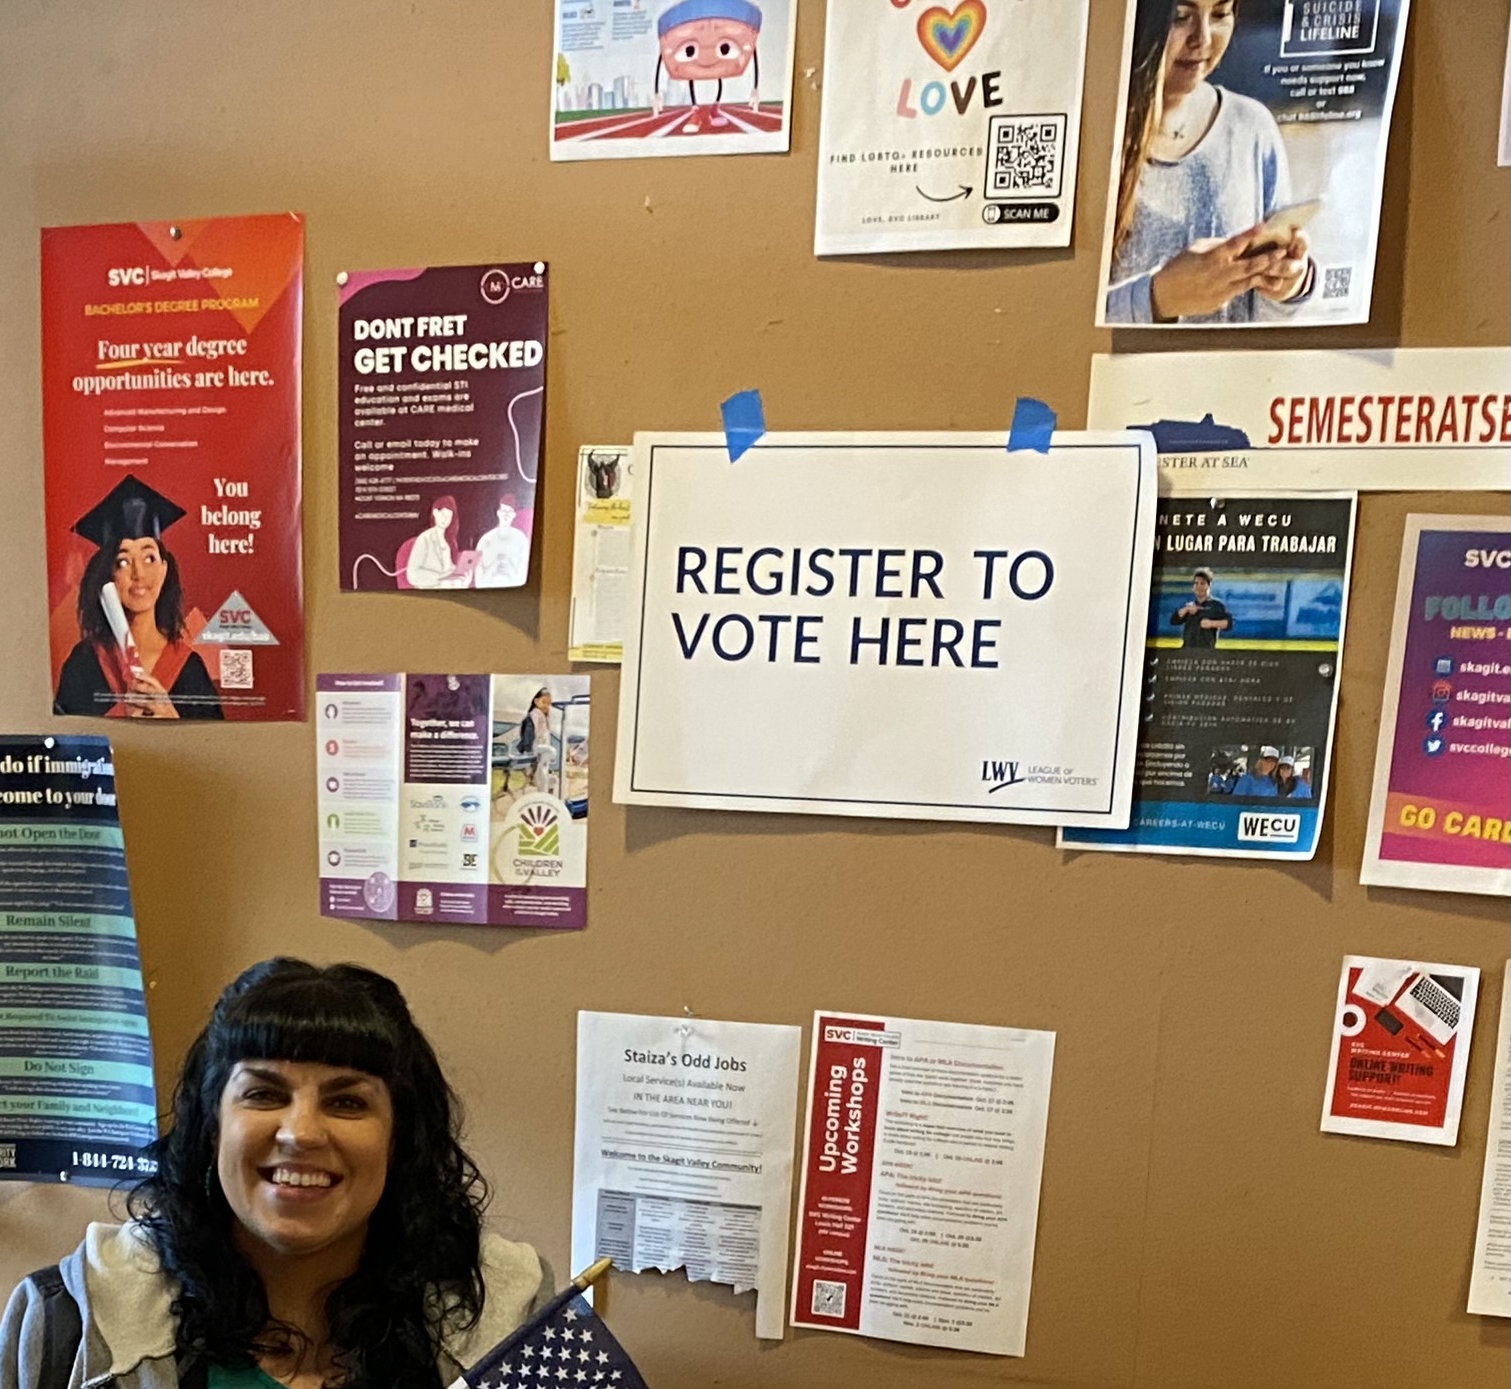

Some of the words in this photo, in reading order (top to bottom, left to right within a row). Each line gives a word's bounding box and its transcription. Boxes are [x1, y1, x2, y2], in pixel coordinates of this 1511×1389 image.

[1301, 16, 1310, 28] &
[1314, 13, 1361, 26] CRISIS
[1300, 25, 1360, 41] LIFELINE
[896, 71, 1004, 119] LOVE
[830, 154, 856, 164] FIND
[890, 163, 919, 174] HERE
[1003, 207, 1031, 220] SCAN
[1033, 207, 1050, 219] ME
[107, 267, 146, 287] SVC
[150, 269, 177, 282] Skagit
[178, 267, 201, 280] Valley
[202, 266, 234, 279] College
[511, 275, 545, 290] CARE
[84, 301, 153, 317] BACHELOR'S
[154, 299, 200, 314] DEGREE
[201, 297, 260, 311] PROGRAM
[353, 317, 416, 341] DONT
[416, 315, 468, 338] FRET
[98, 340, 140, 361] Four
[143, 338, 183, 363] year
[186, 335, 247, 360] degree
[353, 346, 408, 375] GET
[410, 339, 544, 373] CHECKED
[72, 367, 192, 396] opportunities
[194, 372, 225, 388] are
[228, 365, 275, 387] here.
[354, 383, 375, 394] Free
[376, 383, 395, 393] and
[396, 381, 452, 393] confidential
[354, 394, 400, 405] education
[402, 394, 420, 404] and
[422, 394, 452, 403] exams
[454, 393, 470, 403] are
[354, 406, 396, 417] available
[397, 405, 408, 415] at
[410, 405, 435, 415] CARE
[436, 402, 475, 414] medical
[1199, 455, 1221, 469] AT
[213, 477, 249, 498] You
[201, 505, 262, 530] belong
[1159, 514, 1207, 527] NETE
[1217, 513, 1228, 527] A
[1239, 513, 1293, 527] WECU
[208, 533, 255, 554] here!
[1166, 534, 1213, 553] LUGAR
[1218, 534, 1256, 552] PARA
[1261, 535, 1338, 554] TRABAJAR
[675, 546, 945, 600] REGISTER
[973, 549, 1055, 601] TO
[670, 612, 824, 664] VOTE
[849, 616, 1002, 668] HERE
[1449, 625, 1496, 641] NEWS
[26, 755, 44, 774] if
[981, 760, 1020, 782] LWV
[1028, 766, 1061, 775] LEAGUE
[1028, 776, 1063, 785] WOMEN
[1064, 777, 1097, 786] VOTERS
[45, 787, 64, 805] to
[64, 790, 95, 810] your
[1243, 816, 1297, 837] WECU
[1399, 804, 1436, 830] GO
[20, 827, 58, 843] Open
[59, 827, 79, 840] the
[512, 858, 563, 869] CHILDREN
[5, 914, 56, 928] Remain
[57, 914, 92, 929] Silent
[5, 965, 51, 981] Report
[53, 965, 73, 978] the
[826, 1029, 852, 1041] SVC
[23, 1060, 43, 1073] Do
[44, 1060, 68, 1073] Not
[68, 1061, 95, 1076] Sign
[623, 1048, 678, 1067] Staiza's
[681, 1053, 711, 1069] Odd
[714, 1056, 748, 1073] Jobs
[622, 1074, 644, 1084] Local
[686, 1079, 724, 1091] Available
[725, 1082, 746, 1093] Now
[9, 1101, 35, 1111] your
[37, 1100, 71, 1113] Family
[633, 1092, 643, 1101] IN
[645, 1092, 661, 1102] THE
[662, 1095, 684, 1105] AREA
[686, 1097, 710, 1107] NEAR
[818, 1064, 848, 1173] Upcoming
[840, 1056, 869, 1175] Workshops
[601, 1149, 636, 1160] Welcome
[638, 1152, 646, 1162] to
[648, 1153, 661, 1163] the
[663, 1155, 686, 1167] Skagit
[686, 1158, 711, 1170] Valley
